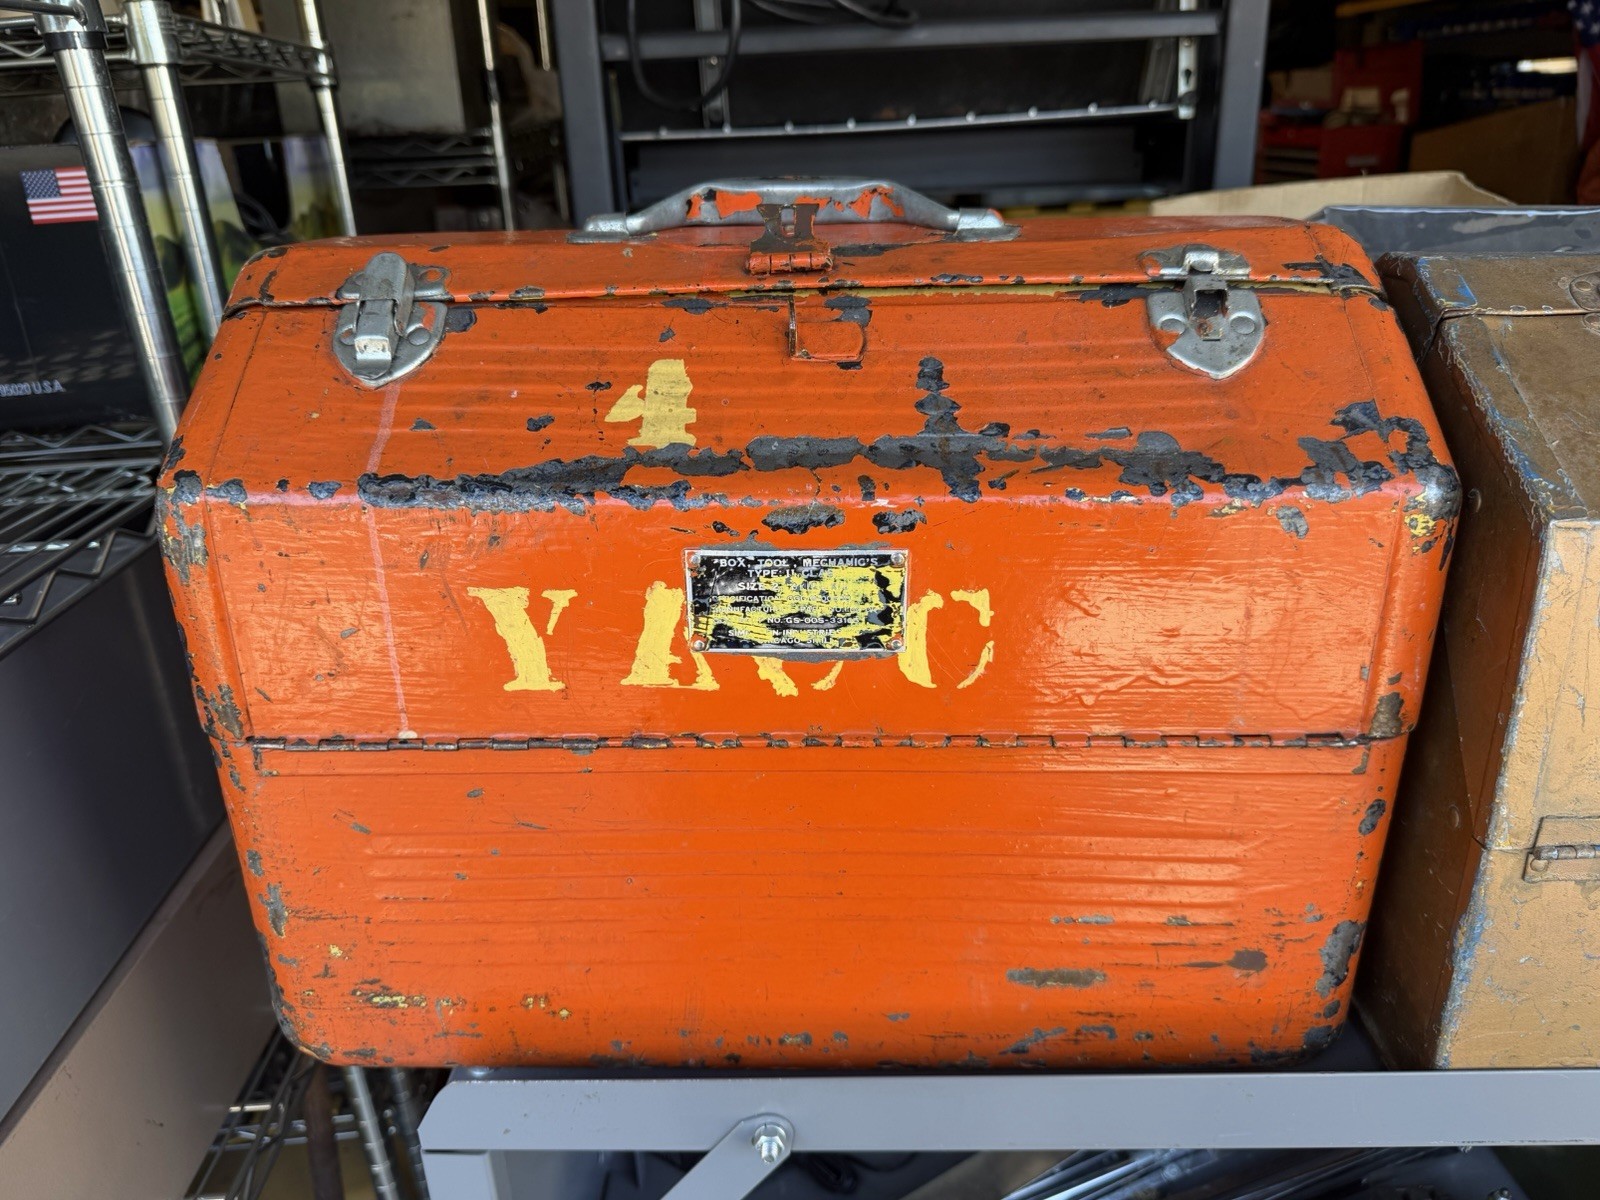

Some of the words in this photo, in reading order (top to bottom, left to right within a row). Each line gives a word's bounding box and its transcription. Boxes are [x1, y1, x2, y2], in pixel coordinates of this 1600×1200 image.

[604, 358, 697, 449] 4
[720, 558, 751, 568] BOX,
[802, 557, 878, 567] MECHANIC'S
[747, 569, 782, 578] TYPE:
[737, 581, 766, 591] SIZE
